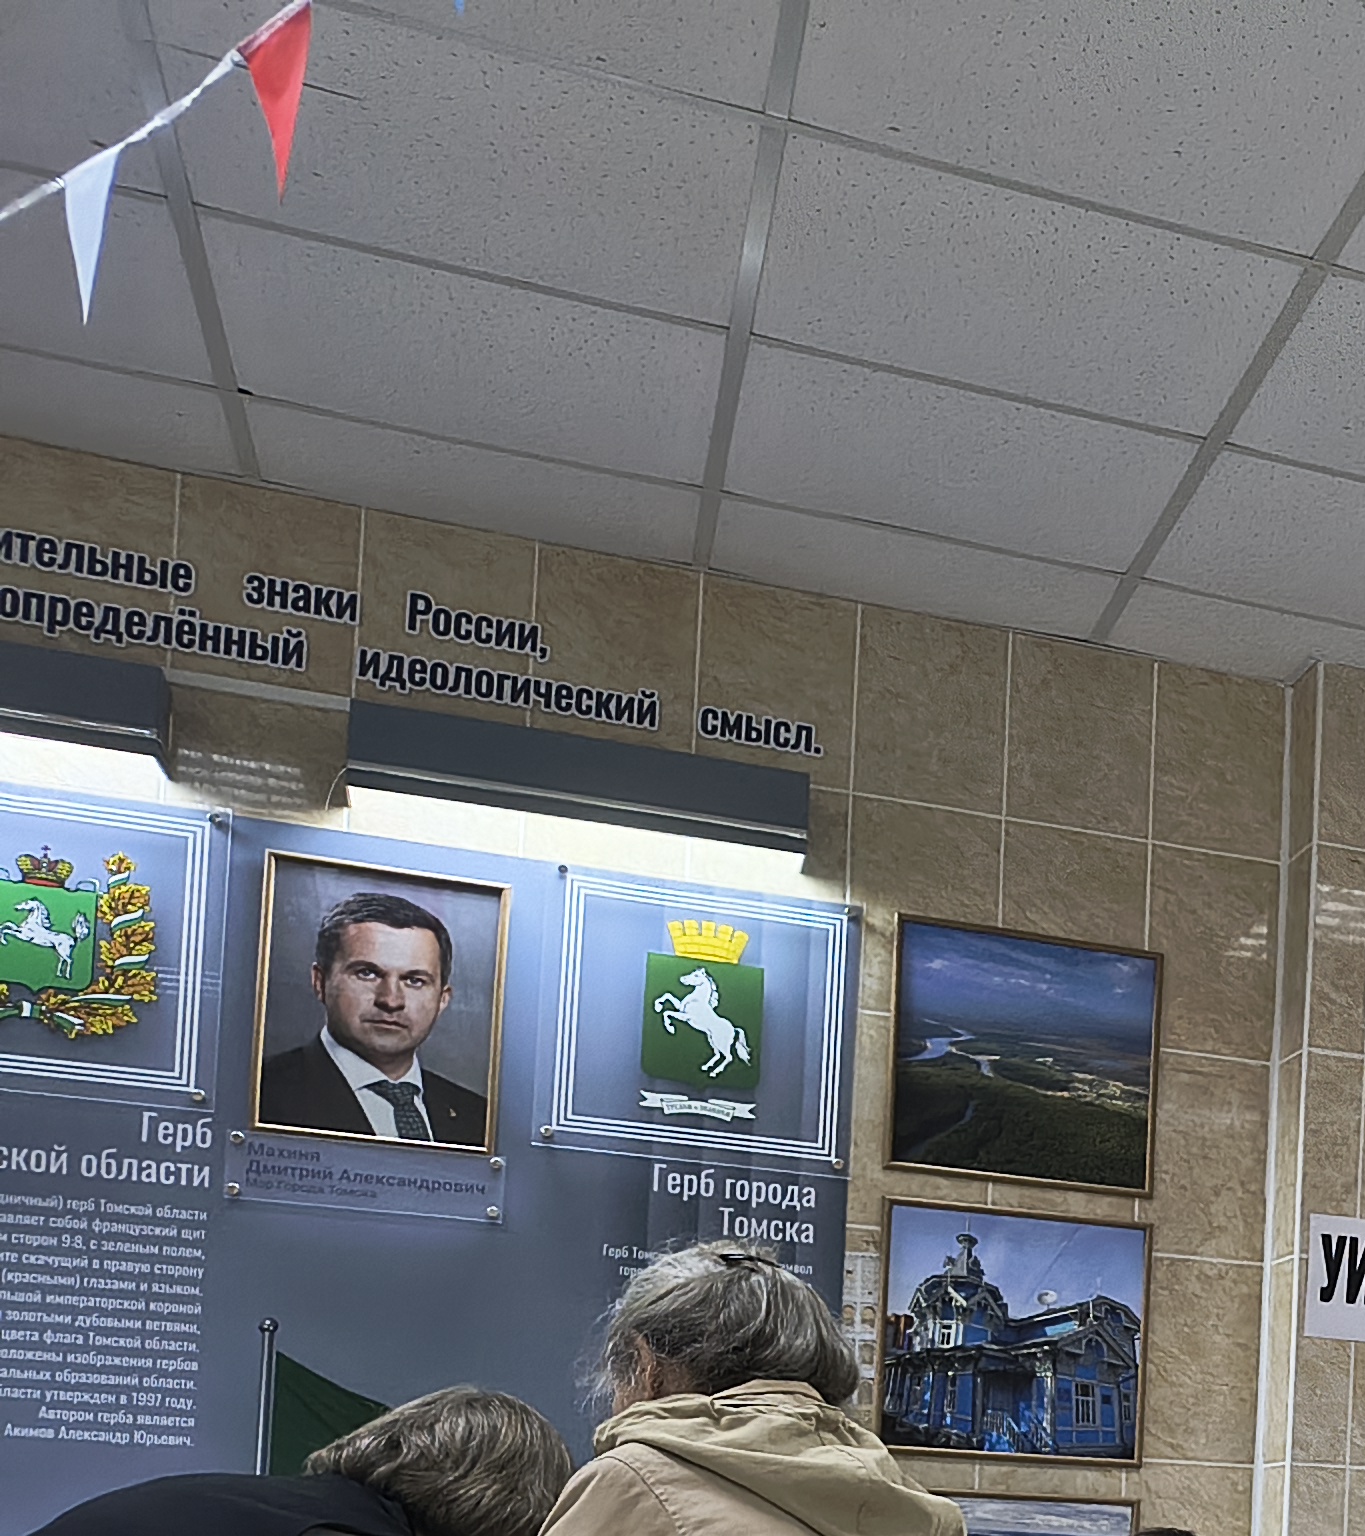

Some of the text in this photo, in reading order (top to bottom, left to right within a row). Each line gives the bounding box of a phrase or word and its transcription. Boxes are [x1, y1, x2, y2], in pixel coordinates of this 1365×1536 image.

[244, 572, 359, 626] знаки
[406, 591, 549, 661] России,
[0, 586, 823, 758] определённый идеологический смысл.
[141, 1111, 212, 1152] Герб
[247, 1142, 320, 1162] Махиня
[81, 1149, 210, 1188] области
[246, 1159, 486, 1195] Дмитрий Александрович
[653, 1163, 816, 1209] Герб города
[100, 1199, 152, 1216] Томской
[156, 1205, 207, 1221] области
[49, 1215, 88, 1229] собой
[92, 1218, 177, 1238] французский
[181, 1228, 206, 1241] щит
[719, 1207, 814, 1244] Томска
[11, 1233, 58, 1247] сторон
[90, 1239, 98, 1250] с
[101, 1241, 158, 1256] зеленым
[603, 1243, 629, 1260] Герб
[22, 1253, 88, 1269] скачущий
[103, 1259, 150, 1274] правую
[154, 1265, 204, 1280] сторону
[1, 1268, 81, 1290] (красными)
[83, 1277, 136, 1291] глазами
[139, 1282, 148, 1292] и
[46, 1293, 146, 1310] императорской
[150, 1301, 201, 1316] короной
[5, 1310, 71, 1325] золотыми
[75, 1313, 142, 1329] дубовыми
[1, 1329, 39, 1342] цвета
[43, 1329, 83, 1345] флага
[88, 1332, 142, 1349] Томской
[66, 1351, 153, 1368] изображения
[156, 1356, 199, 1372] гербов
[55, 1369, 139, 1386] образований
[44, 1389, 115, 1405] утвержден
[120, 1394, 127, 1405] в
[132, 1392, 161, 1406] 1997
[165, 1397, 197, 1411] году.
[38, 1405, 195, 1428] Автором герба является
[4, 1422, 55, 1438] Акимов
[58, 1425, 130, 1444] Александр
